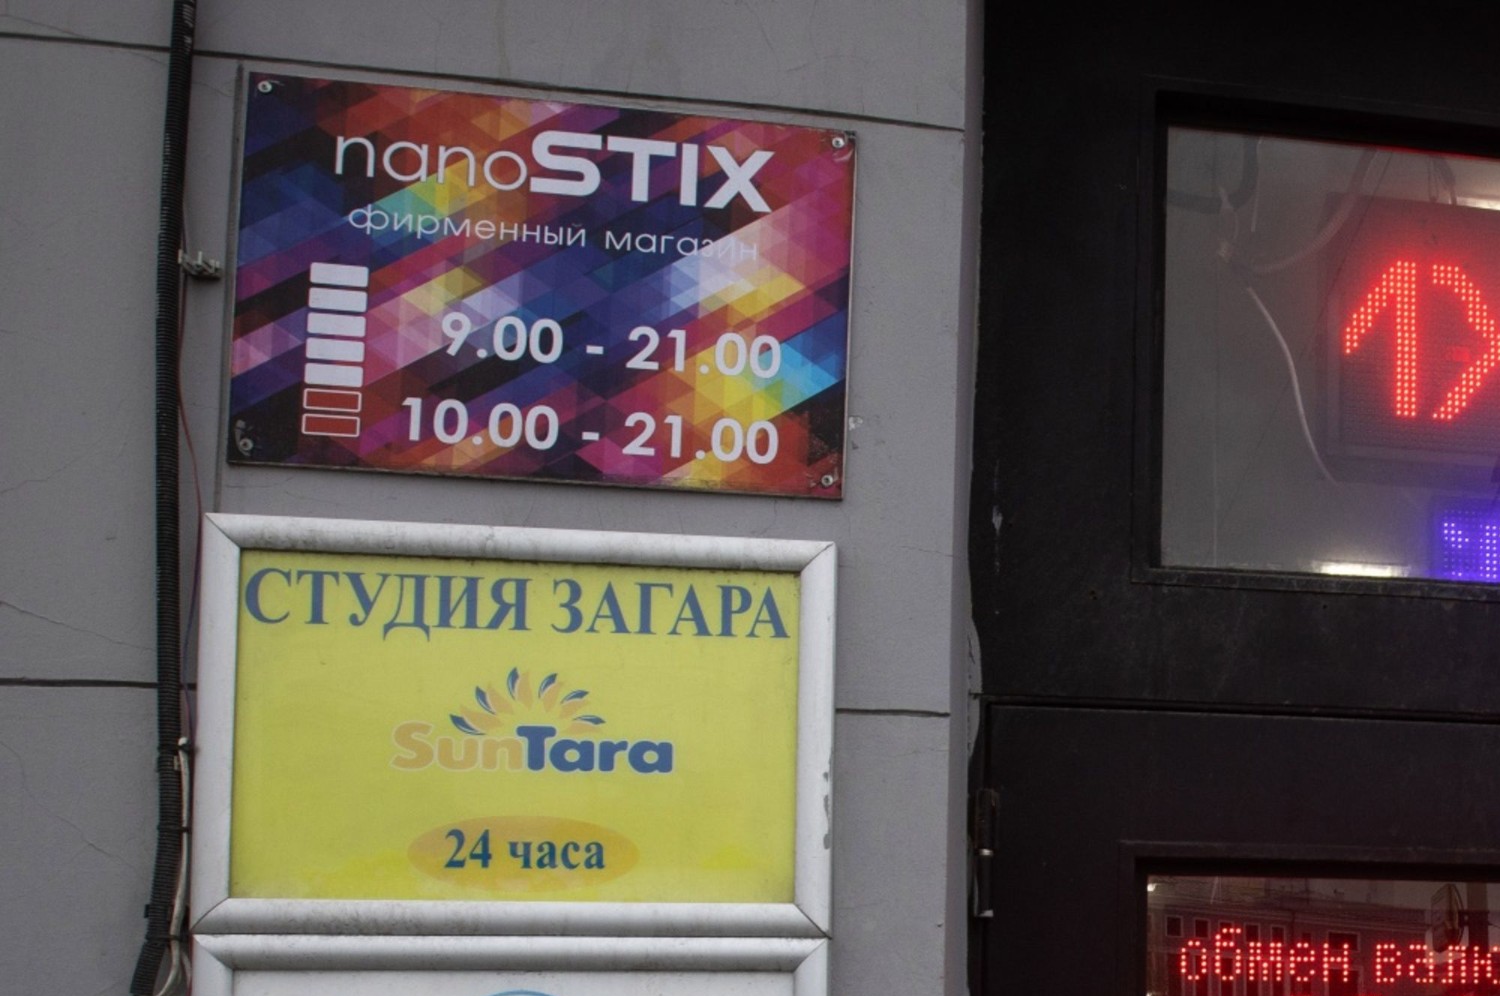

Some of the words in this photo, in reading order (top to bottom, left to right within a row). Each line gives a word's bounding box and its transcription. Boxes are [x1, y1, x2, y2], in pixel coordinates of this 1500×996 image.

[334, 129, 775, 213] nanoSTIX
[347, 202, 587, 248] фирменный
[604, 229, 758, 261] магазин
[441, 311, 563, 364] 9.00
[585, 345, 604, 355] -
[625, 325, 782, 379] 21.00
[401, 396, 559, 450] 10.00
[581, 431, 600, 441] -
[621, 411, 779, 465] 21.00
[244, 567, 531, 642] СТУДИЯ
[551, 578, 791, 639] ЗАГАРА
[390, 720, 675, 774] SunTara
[444, 828, 493, 870] 24
[507, 840, 606, 870] часа
[1180, 928, 1350, 982] обмен
